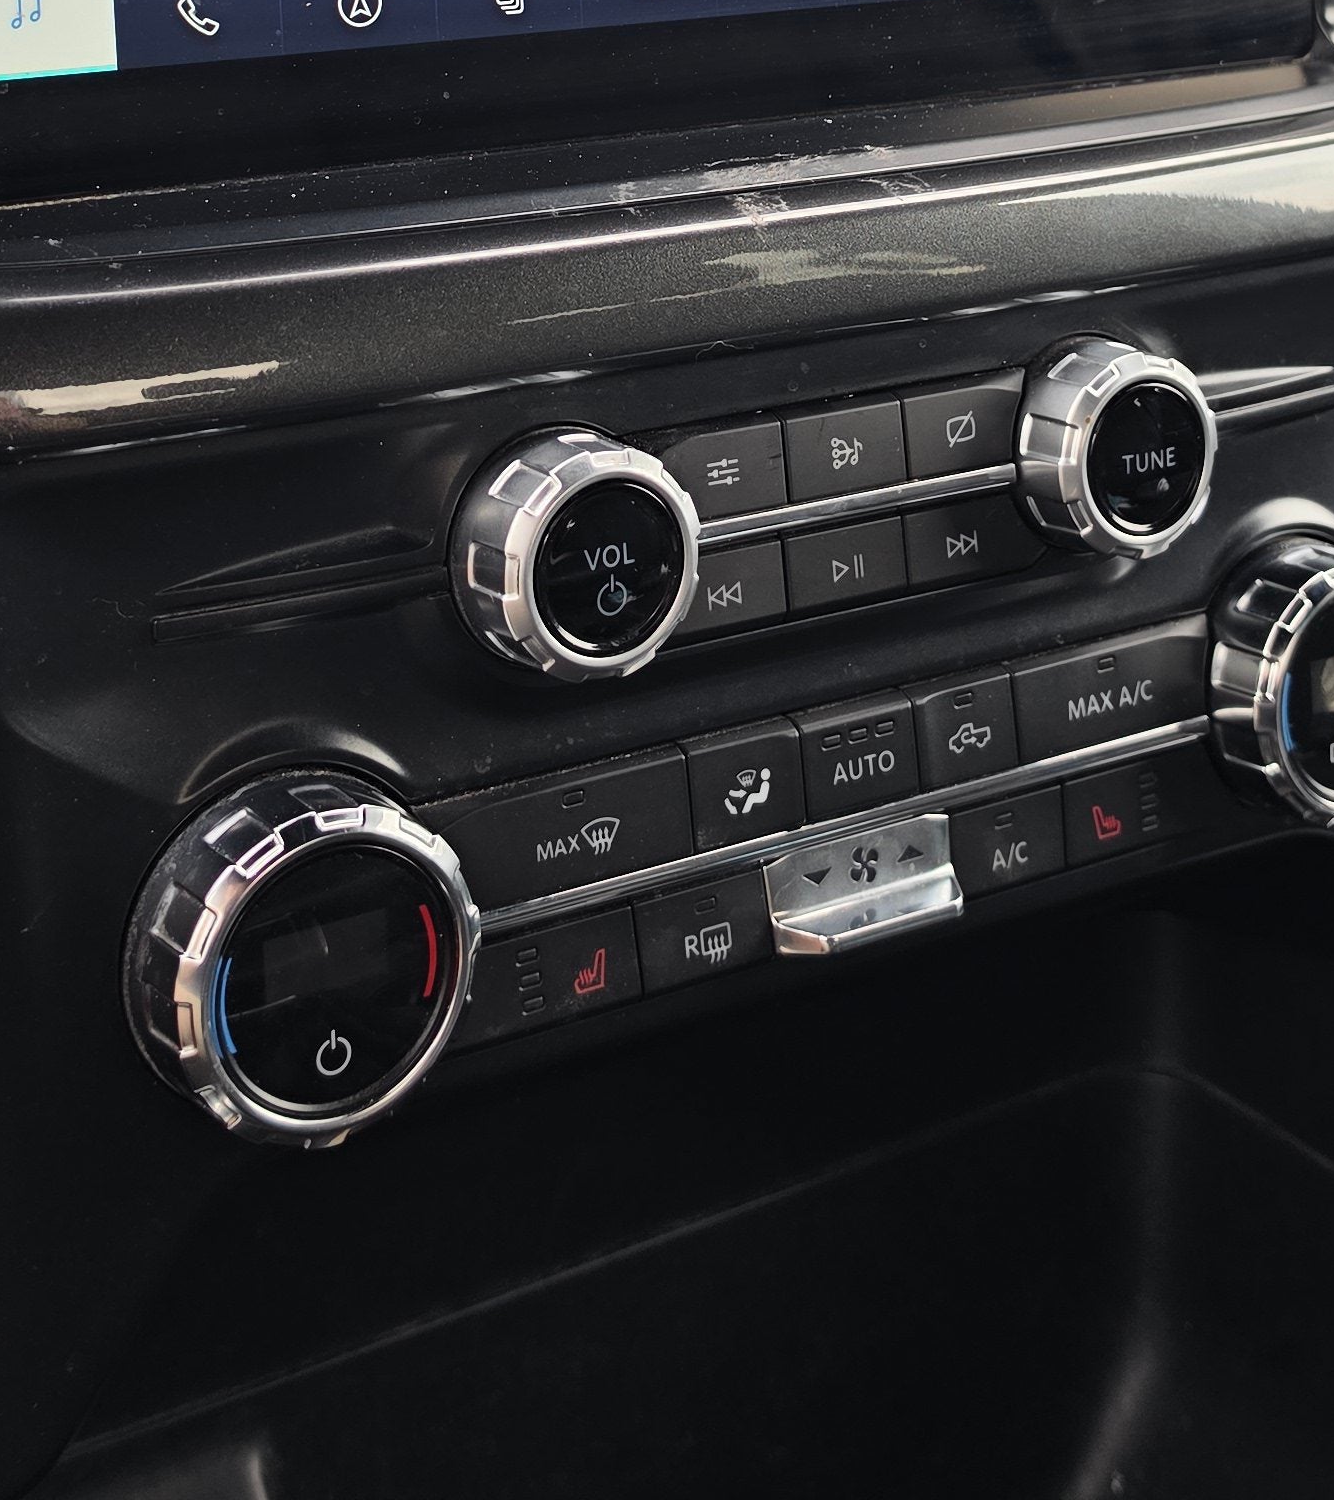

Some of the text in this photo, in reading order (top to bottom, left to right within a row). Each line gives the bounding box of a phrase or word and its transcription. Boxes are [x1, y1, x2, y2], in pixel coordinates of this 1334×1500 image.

[1121, 447, 1177, 475] TUNE
[584, 544, 635, 572] VOL
[1069, 679, 1154, 722] MAX A/C
[833, 749, 896, 786] AUTO
[535, 833, 581, 863] MAX
[992, 841, 1029, 872] A/C
